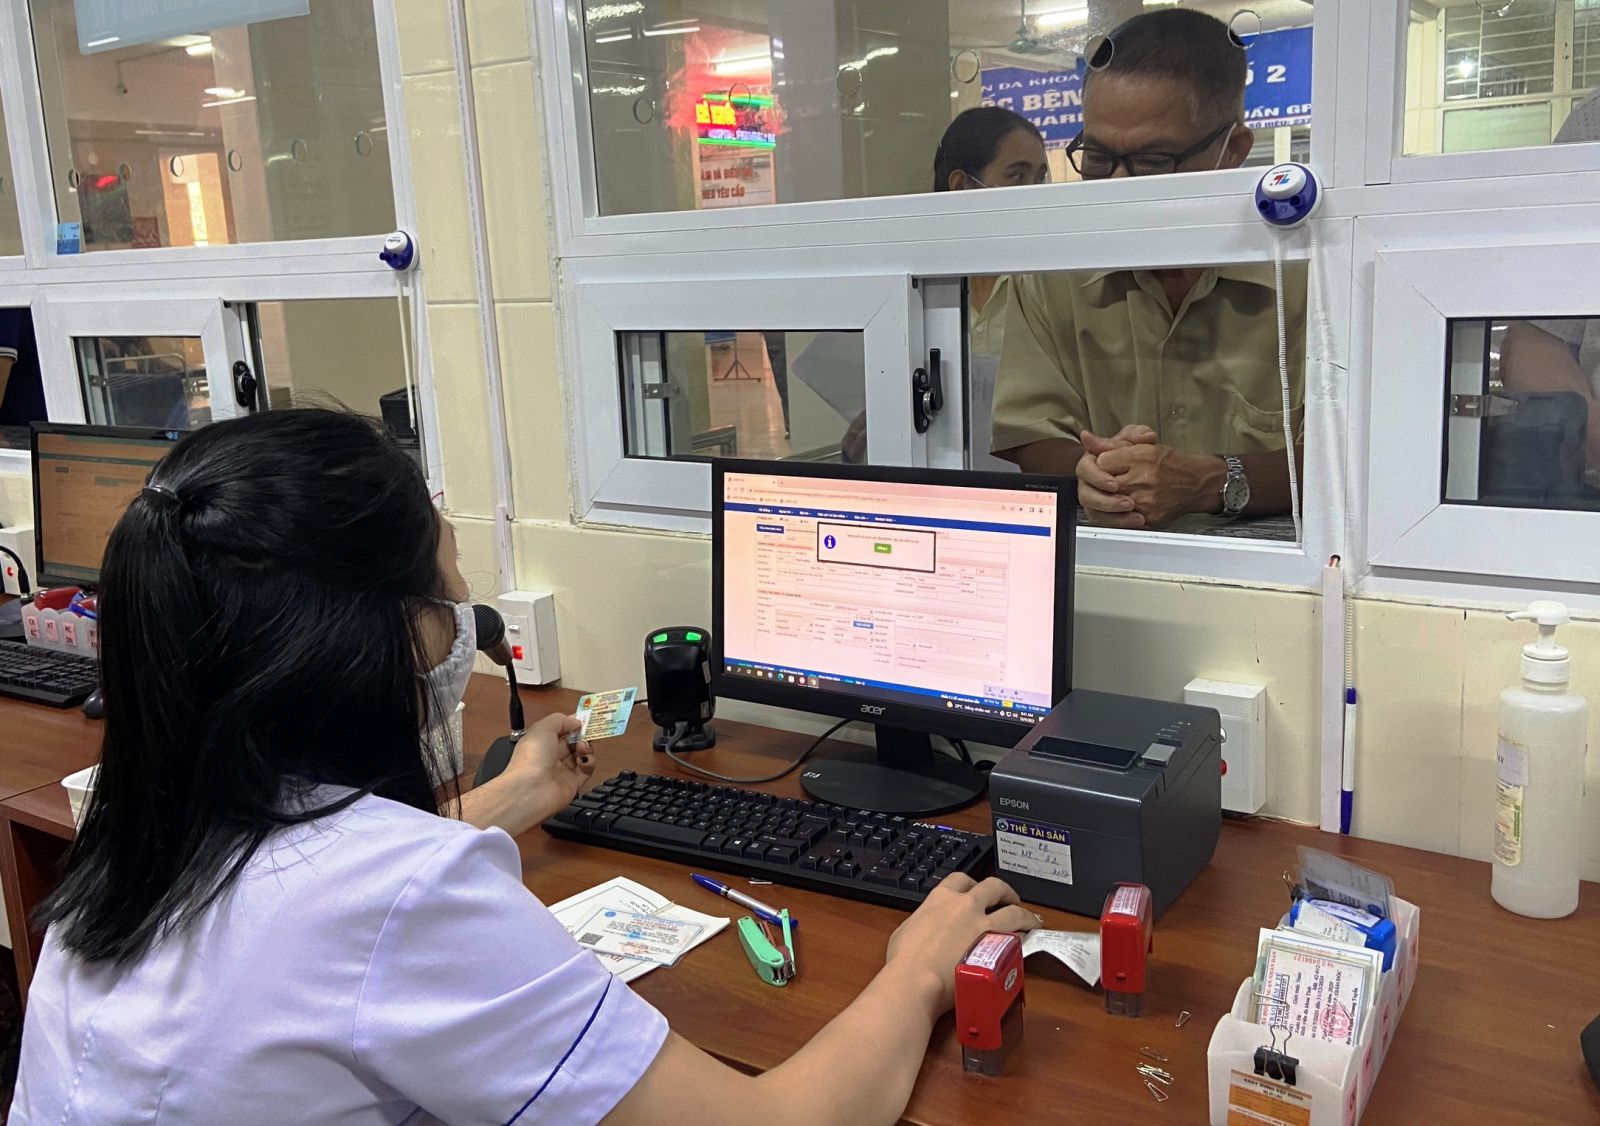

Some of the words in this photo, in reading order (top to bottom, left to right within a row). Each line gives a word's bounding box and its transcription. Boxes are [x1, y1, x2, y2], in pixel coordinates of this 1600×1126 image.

[1029, 74, 1080, 87] KHOA
[1266, 64, 1286, 83] 2
[1023, 88, 1082, 112] BỆN
[860, 704, 886, 716] acer
[999, 797, 1030, 811] EPSON
[1009, 823, 1028, 834] THẺ
[1030, 827, 1044, 838] TÀI
[1046, 829, 1066, 842] SẢN
